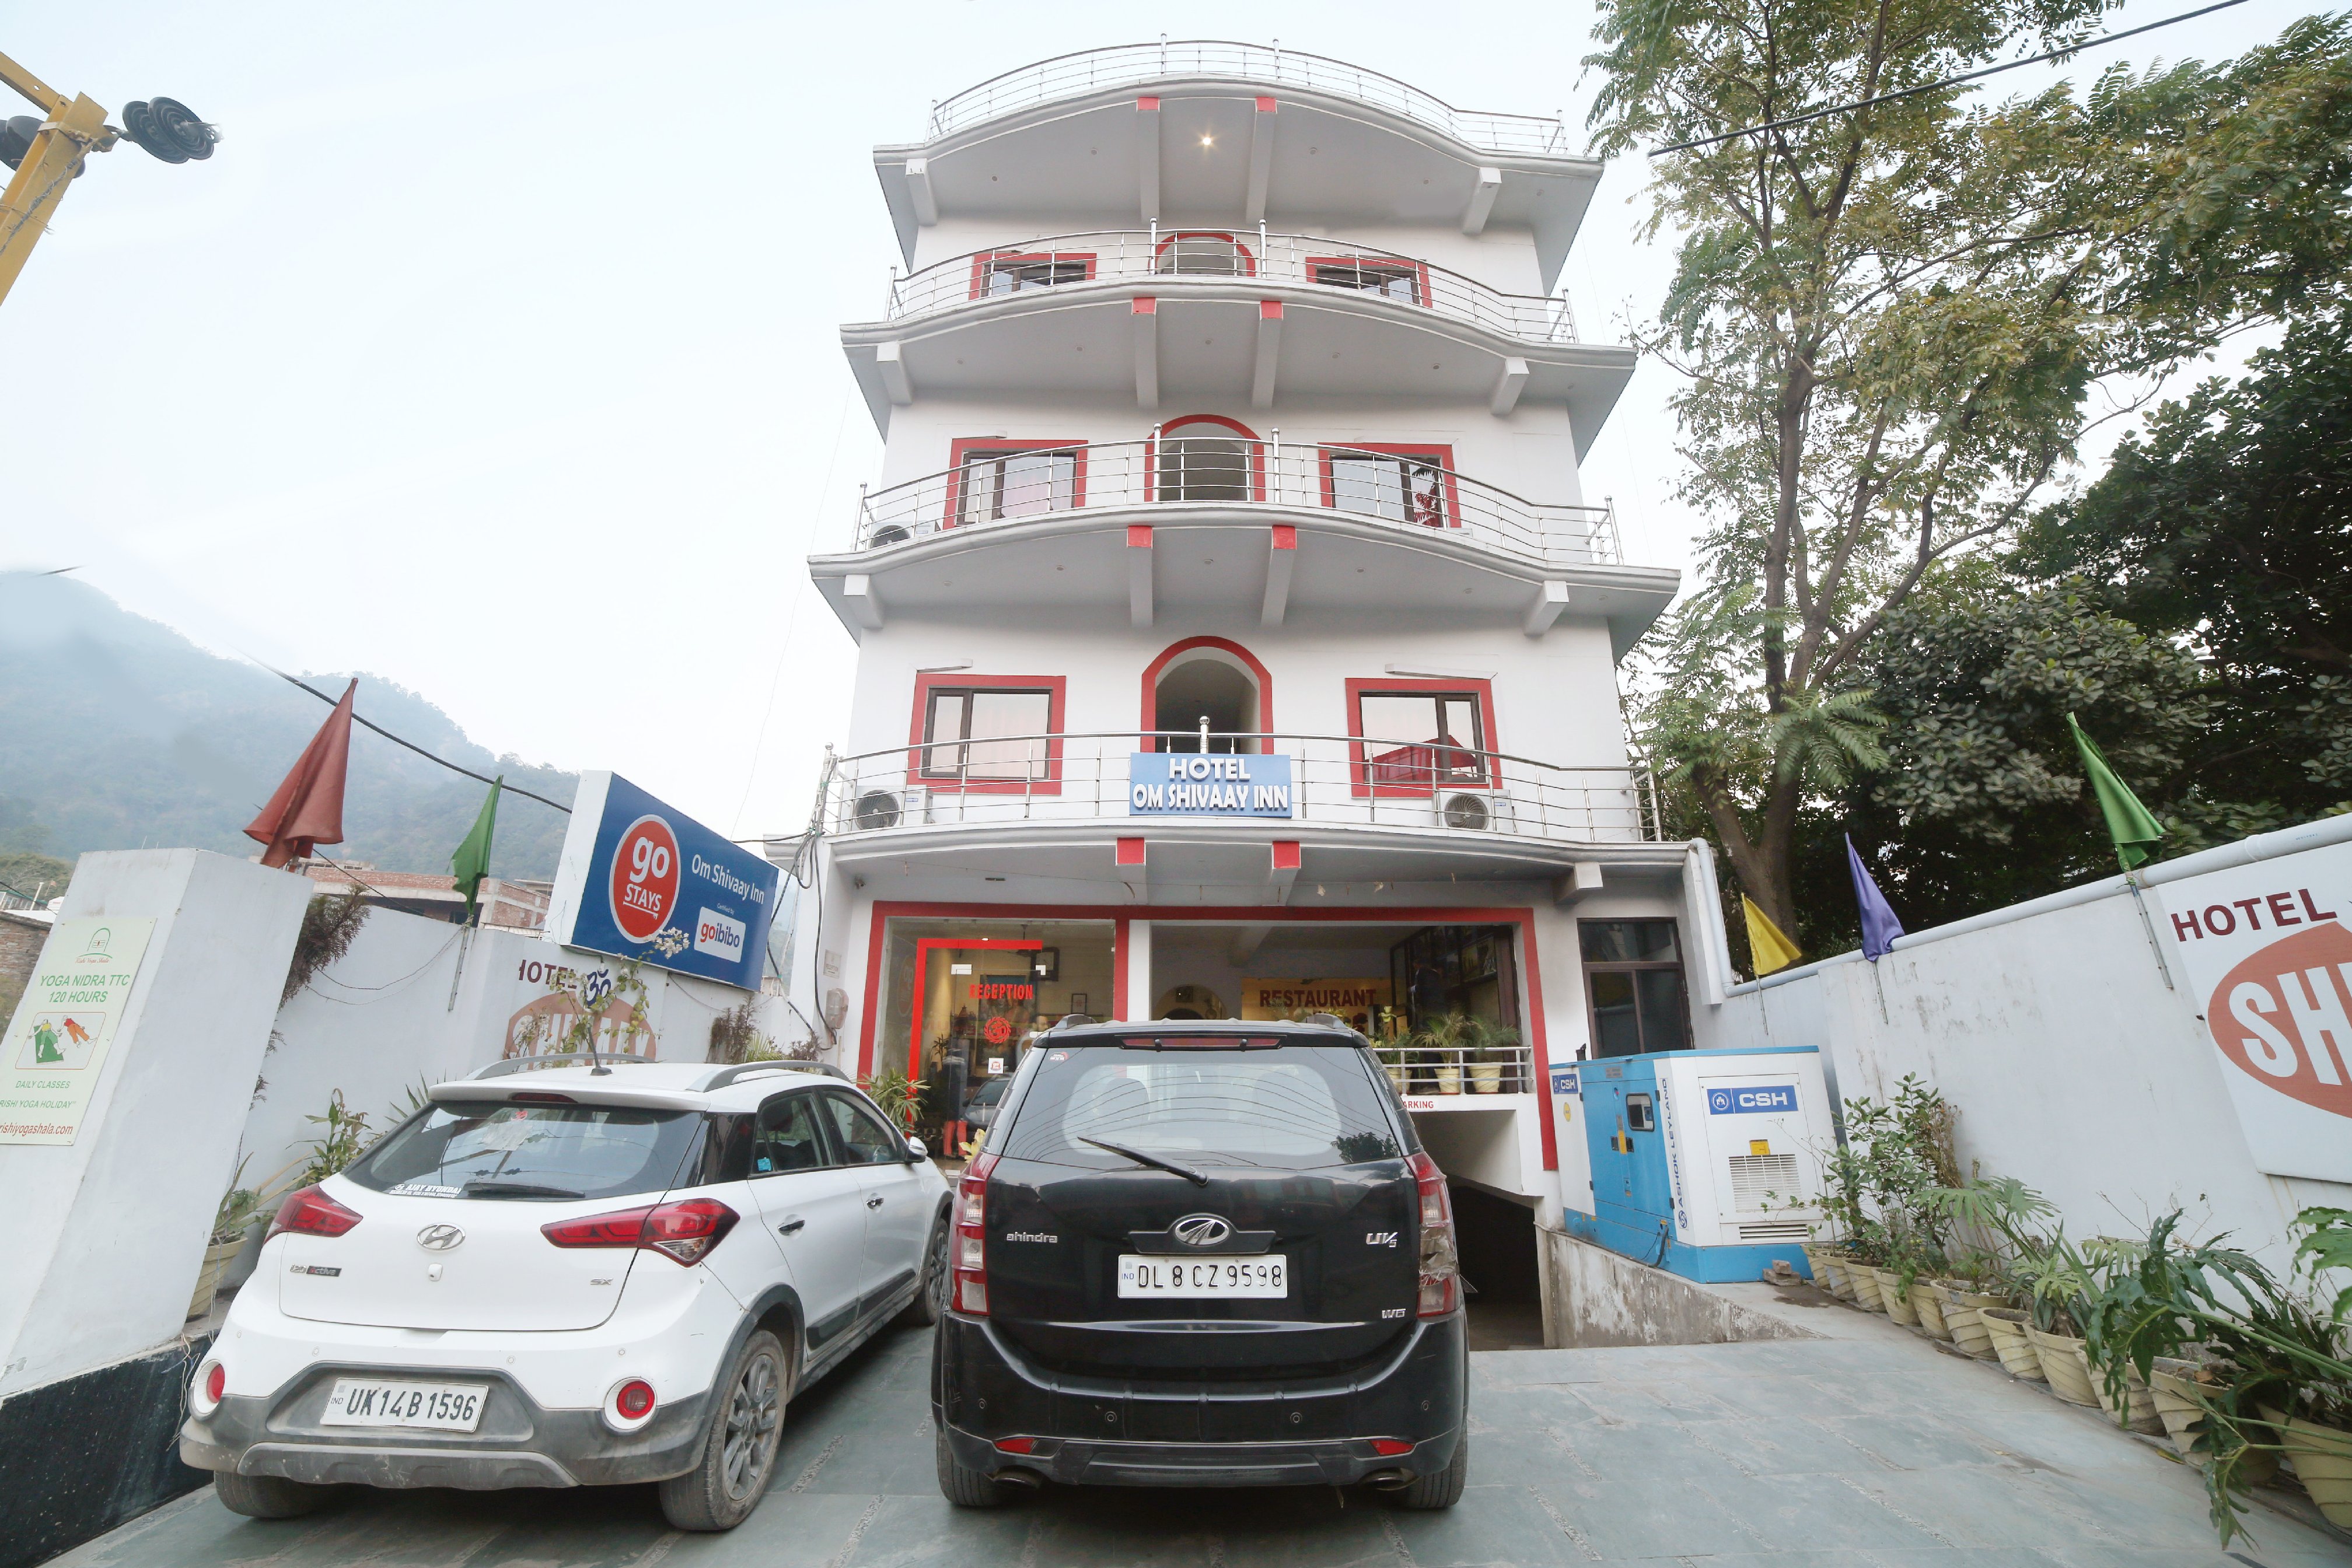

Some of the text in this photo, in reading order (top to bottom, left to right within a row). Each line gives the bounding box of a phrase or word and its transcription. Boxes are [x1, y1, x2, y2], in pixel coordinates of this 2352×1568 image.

[1169, 757, 1250, 780] HOTEL
[1133, 783, 1288, 810] OM SHIVAAY INN
[630, 836, 670, 883] go
[692, 854, 764, 904] Om Shivaay Inn
[624, 883, 662, 911] STAYS
[2171, 888, 2337, 942] HOTEL
[700, 922, 740, 948] goibibo
[40, 974, 130, 986] YOGA NIDRA TTC
[969, 984, 1033, 999] RECEPTION
[49, 991, 108, 1003] 120 HOURS
[1260, 989, 1376, 1007] RESTAURANT
[15, 1080, 37, 1088] DAILY
[1560, 1079, 1575, 1090] CSH
[1739, 1092, 1788, 1107] CSH
[1662, 1079, 1683, 1208] ASHOK LEYLAND
